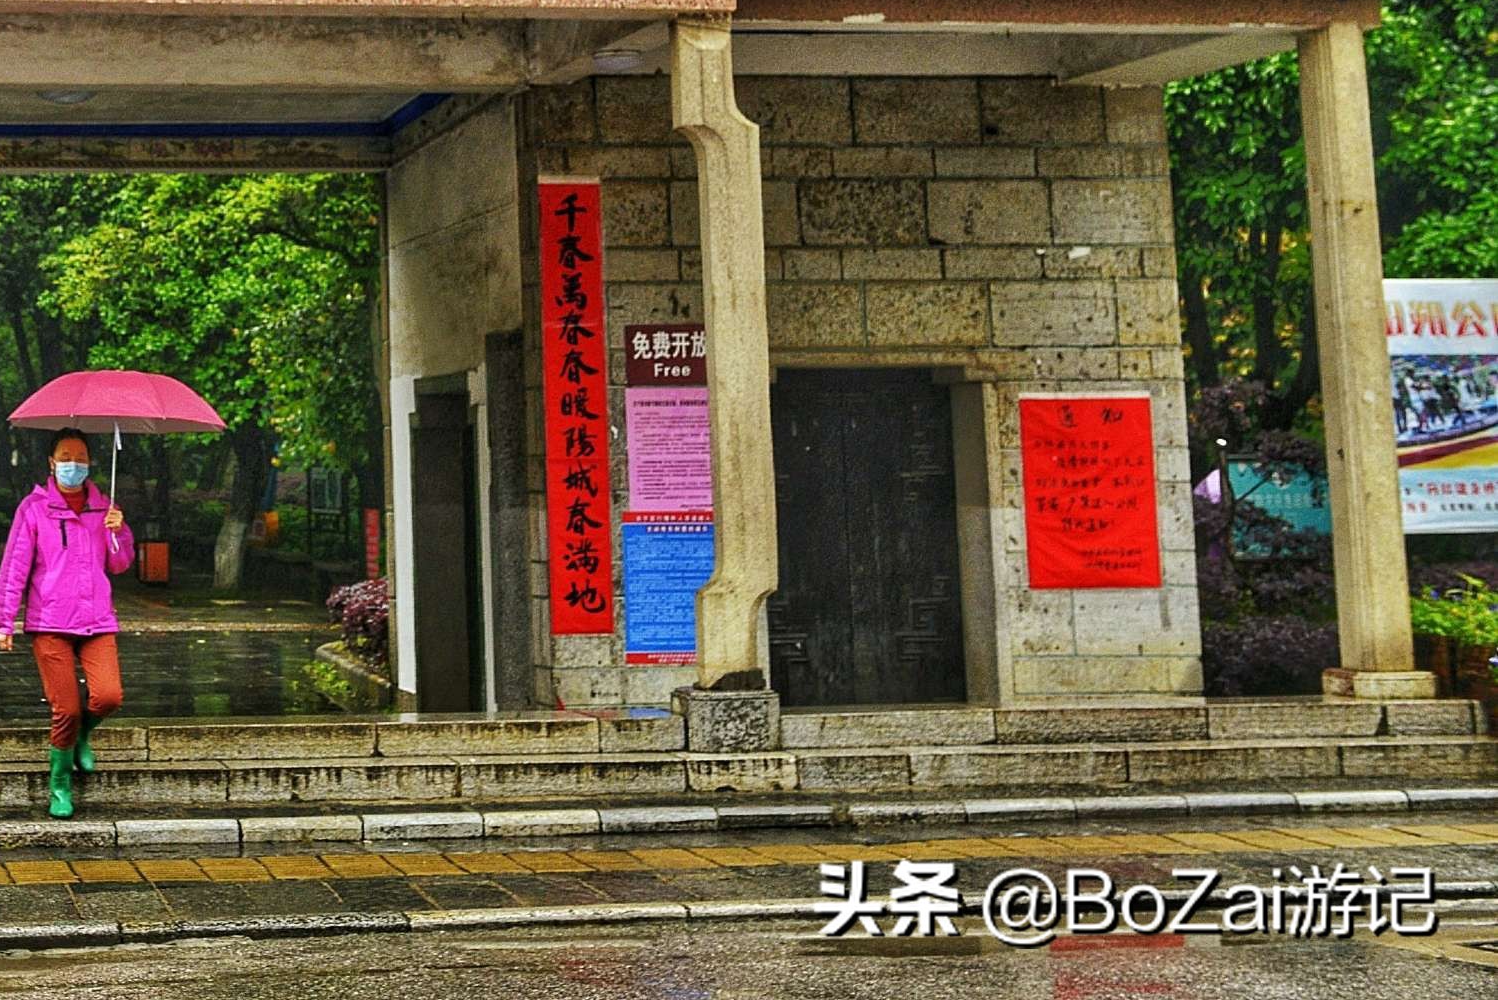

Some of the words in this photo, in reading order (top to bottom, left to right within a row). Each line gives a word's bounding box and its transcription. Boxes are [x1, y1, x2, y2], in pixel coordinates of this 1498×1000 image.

[631, 330, 707, 360] 免费开放
[653, 362, 692, 378] Free
